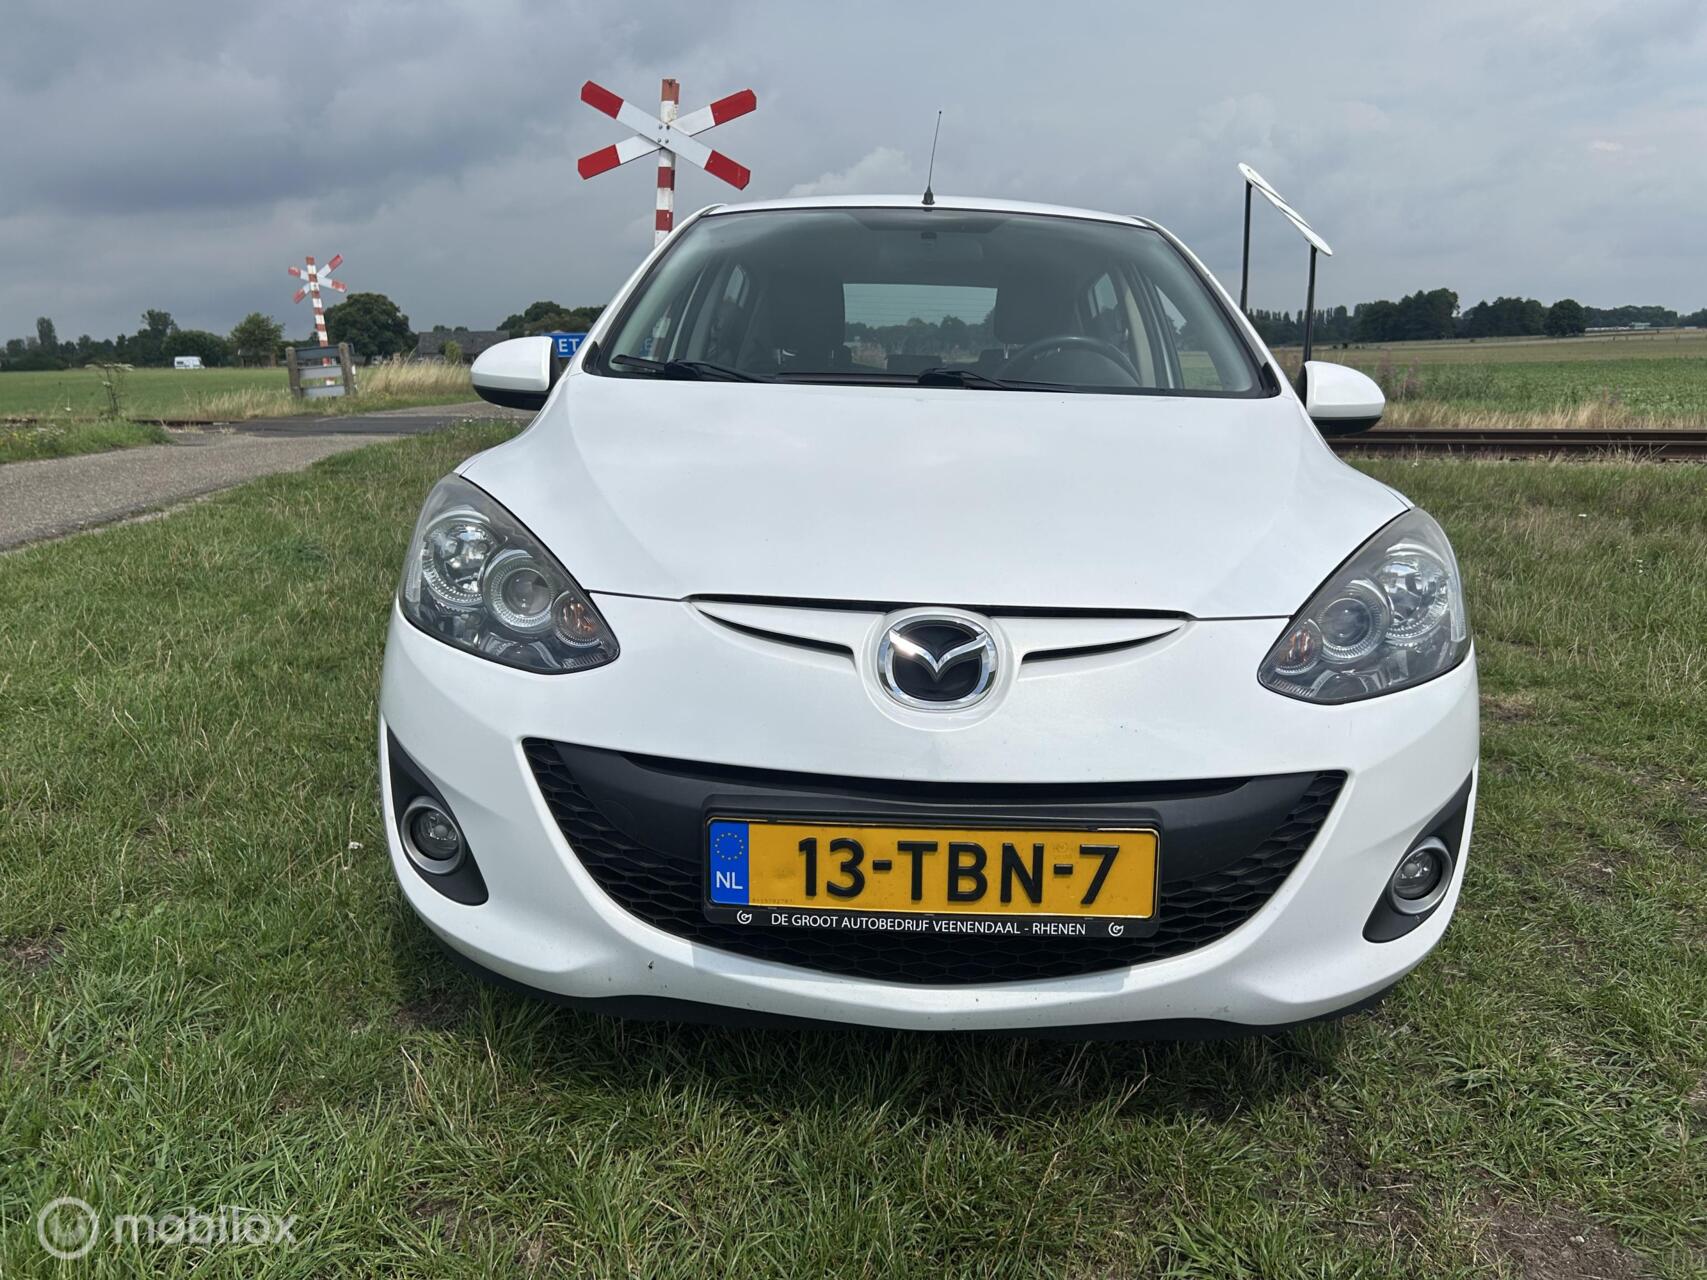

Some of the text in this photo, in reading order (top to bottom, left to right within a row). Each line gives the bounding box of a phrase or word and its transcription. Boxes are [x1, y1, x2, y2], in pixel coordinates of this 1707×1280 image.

[715, 870, 743, 890] NL
[798, 837, 1121, 906] 13-TBN-7
[771, 913, 789, 925] DE
[791, 914, 838, 928] GROOT
[841, 917, 930, 932] AUTOBEDRIJF
[933, 920, 1021, 934] VEENENDAAL
[1032, 923, 1086, 935] RHENEN
